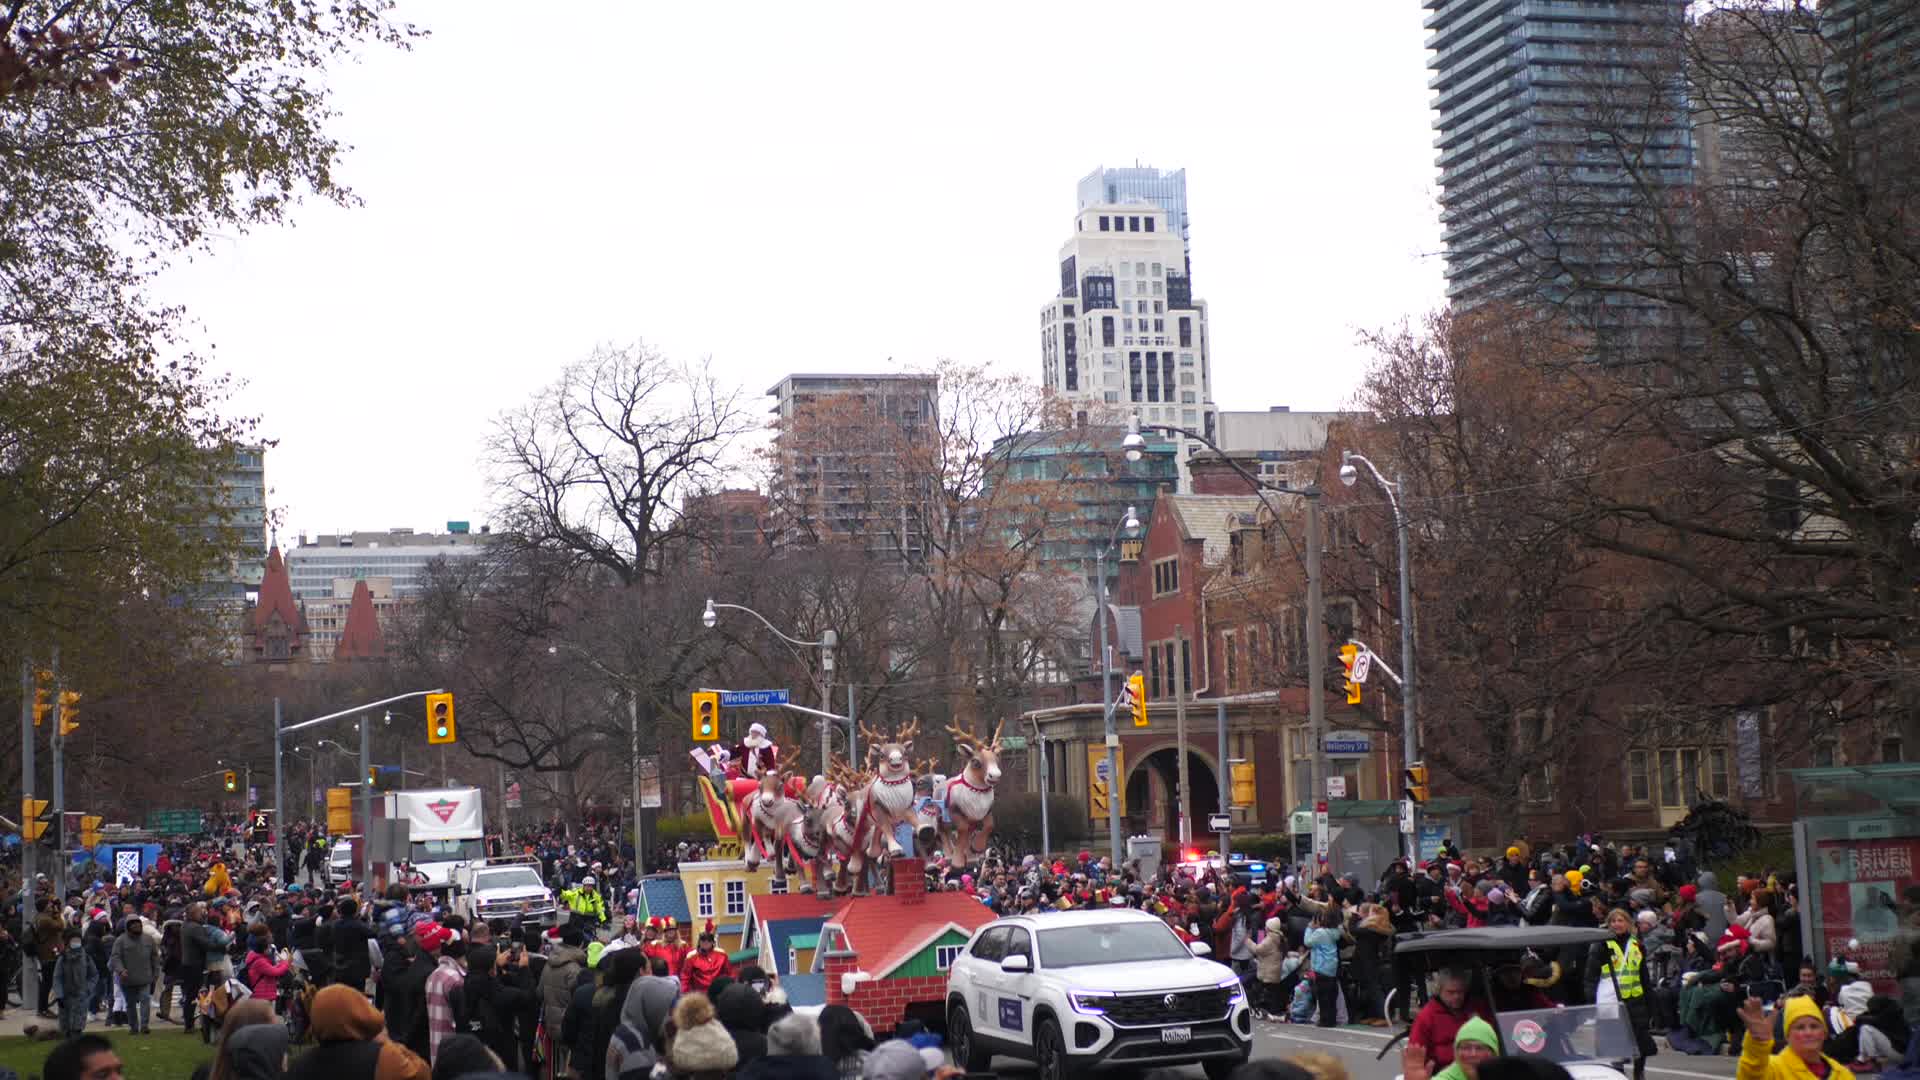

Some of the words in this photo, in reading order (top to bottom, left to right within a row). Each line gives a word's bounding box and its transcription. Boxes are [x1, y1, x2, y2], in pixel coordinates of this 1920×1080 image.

[724, 693, 769, 705] Wellesley
[778, 690, 787, 701] W
[1327, 742, 1355, 752] Wellesley
[1849, 856, 1912, 870] DRIVEN
[1164, 1030, 1190, 1041] Milton
